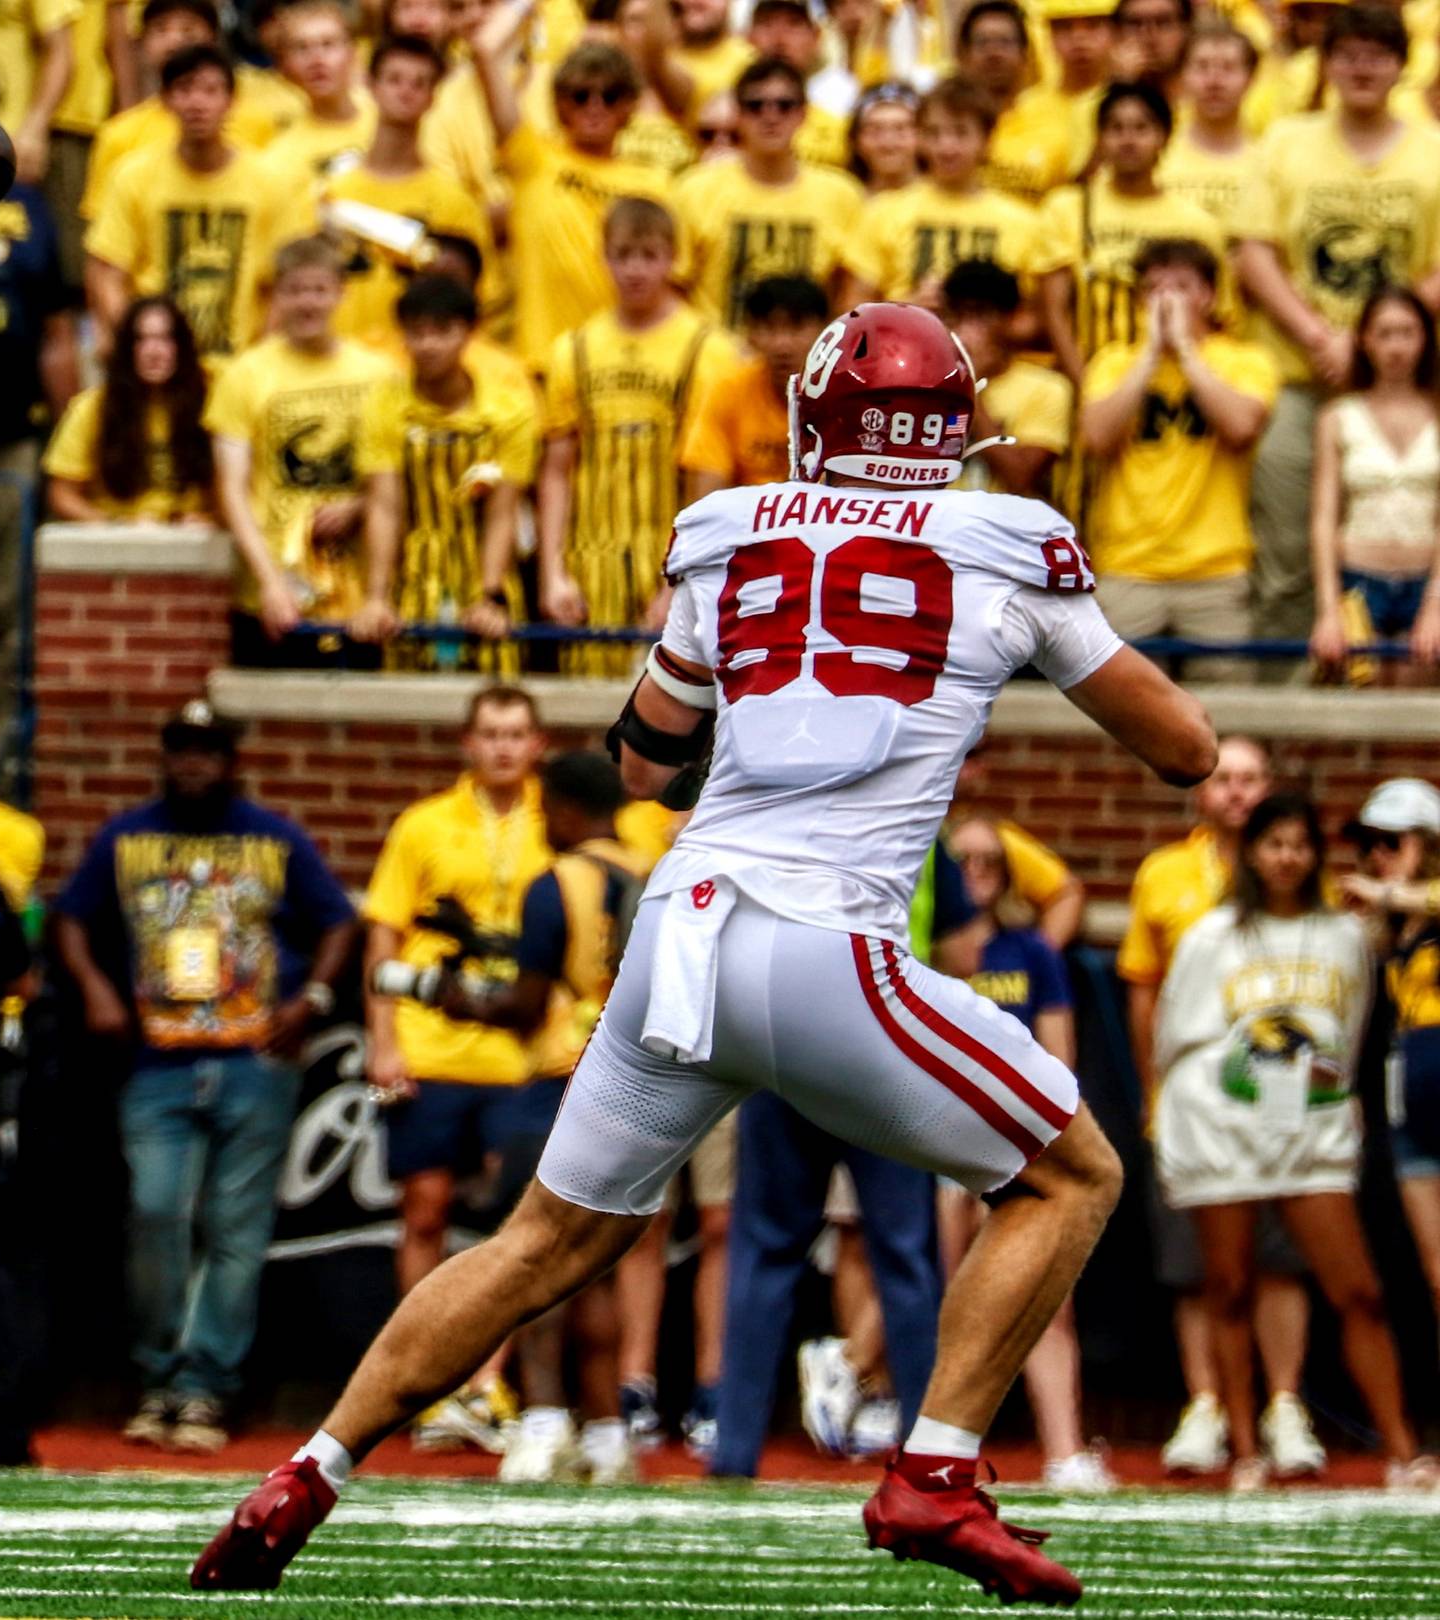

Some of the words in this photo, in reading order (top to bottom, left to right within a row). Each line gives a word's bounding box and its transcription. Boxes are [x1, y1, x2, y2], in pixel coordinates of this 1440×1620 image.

[863, 409, 883, 431] SEC
[889, 411, 944, 447] 89
[864, 463, 950, 482] SOONERS
[752, 491, 934, 538] HANSEN
[1040, 536, 1096, 593] 8
[714, 535, 955, 708] 89
